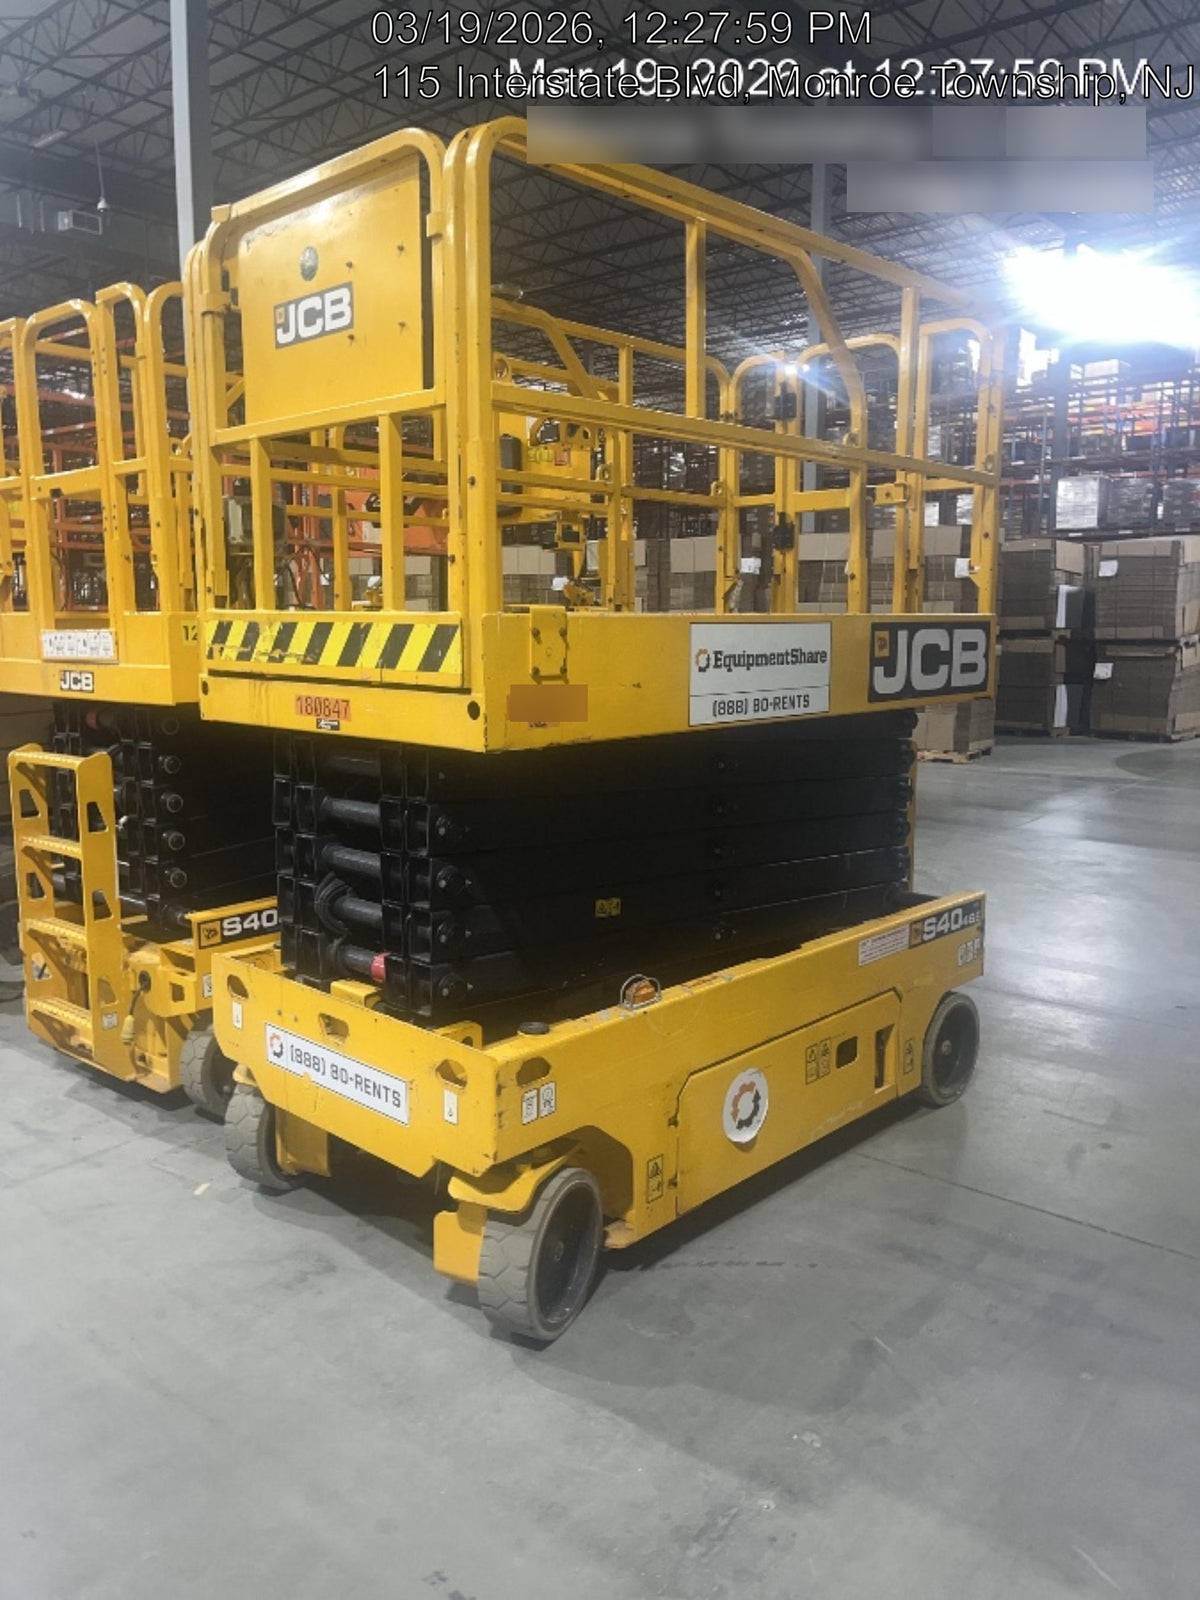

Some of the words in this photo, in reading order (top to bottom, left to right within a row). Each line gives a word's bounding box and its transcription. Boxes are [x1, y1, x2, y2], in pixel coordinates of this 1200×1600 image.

[276, 286, 352, 345] JCB
[712, 646, 828, 673] EquipmentShare
[872, 628, 988, 695] JCB
[60, 670, 94, 692] JCB
[296, 696, 350, 719] 180847
[712, 698, 748, 718] (888)
[753, 694, 810, 713] 80-RENTS
[222, 908, 278, 936] S40
[289, 1044, 327, 1077] (888)
[330, 1063, 402, 1109] 80-RENTS
